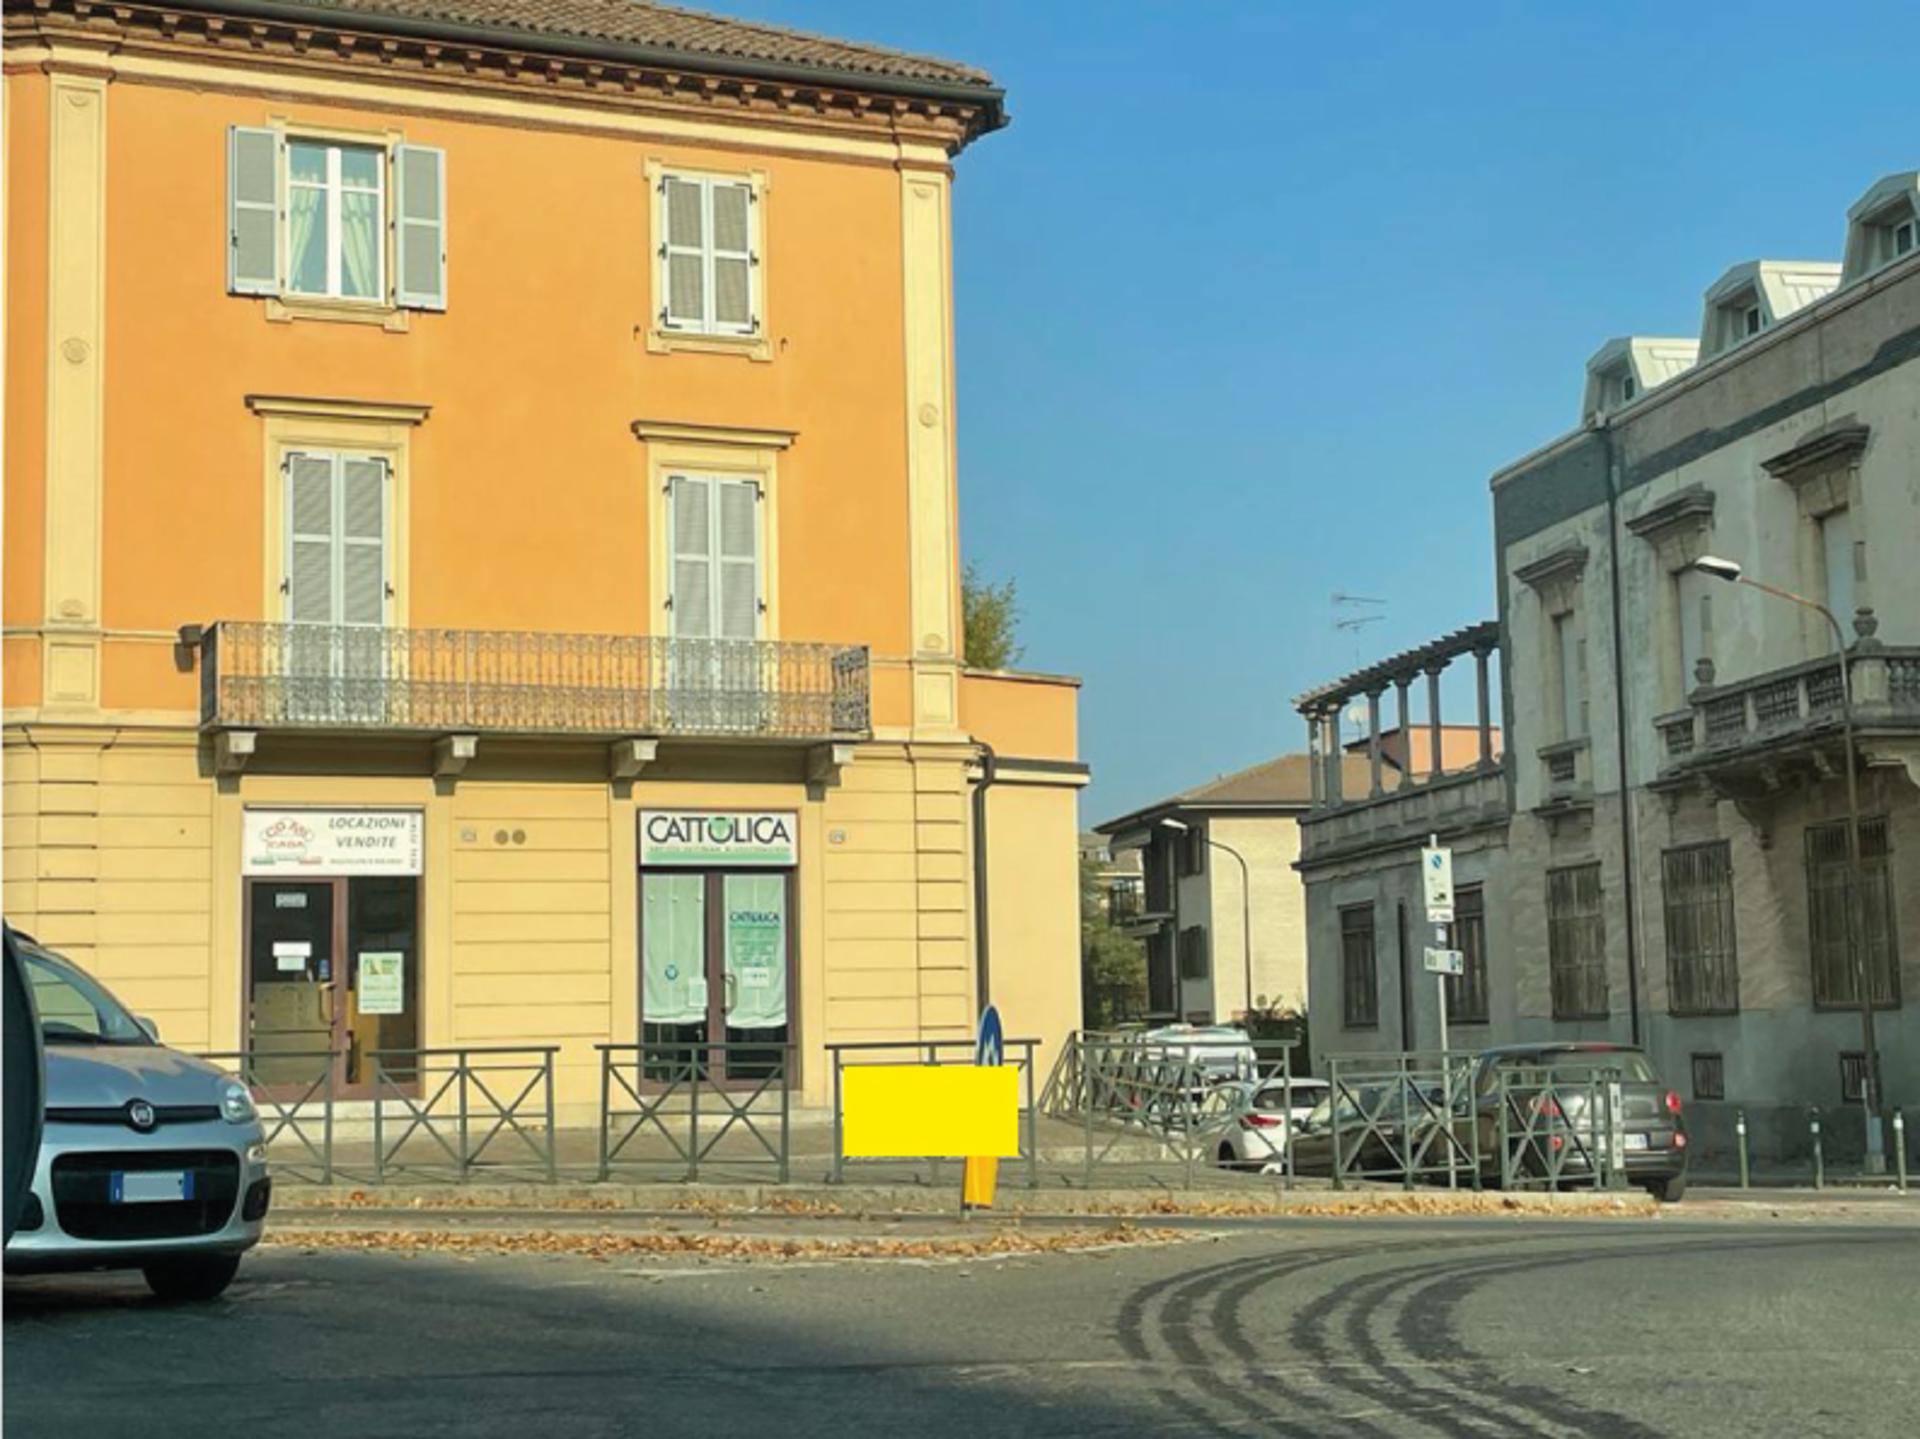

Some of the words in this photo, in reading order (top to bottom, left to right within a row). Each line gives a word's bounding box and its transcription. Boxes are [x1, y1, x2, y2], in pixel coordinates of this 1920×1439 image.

[328, 817, 406, 830] LOCAZIONI
[648, 815, 791, 844] CATTOLICA
[335, 836, 397, 849] VENDITE
